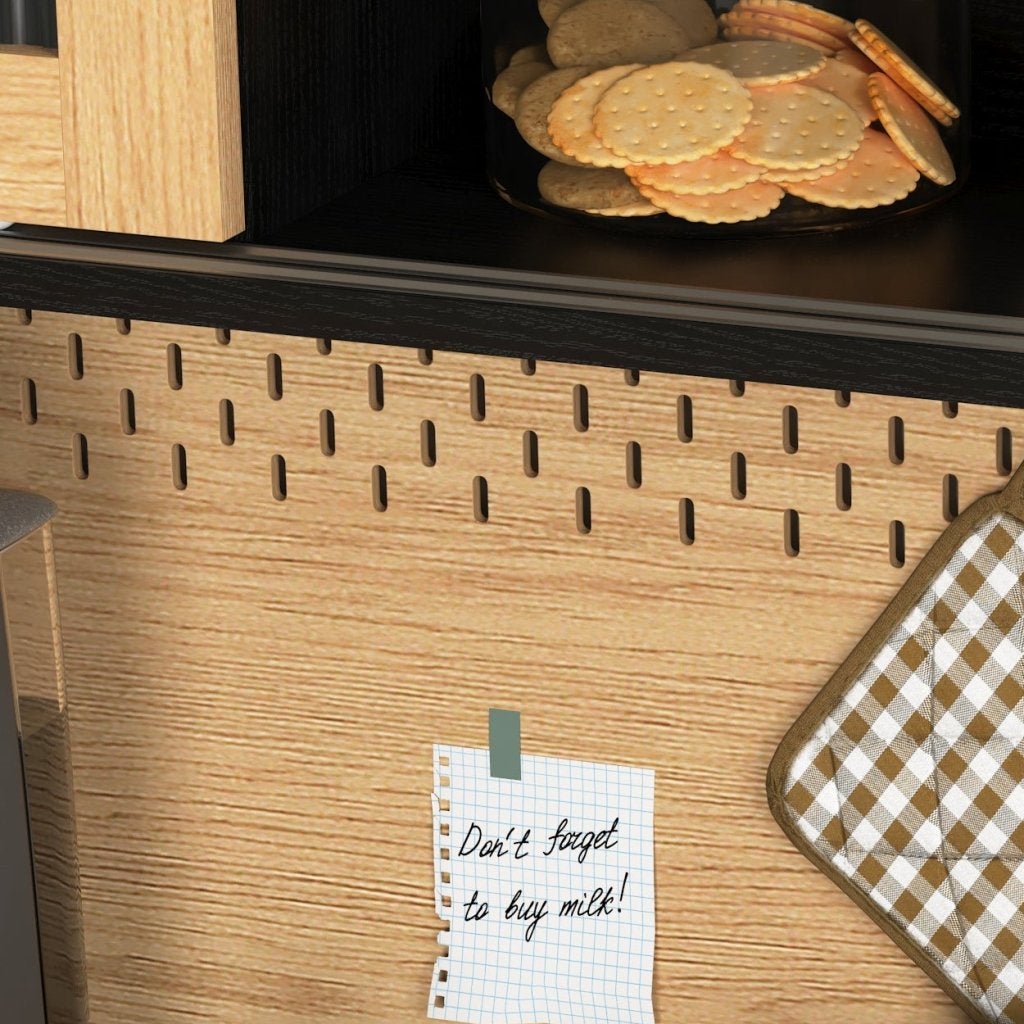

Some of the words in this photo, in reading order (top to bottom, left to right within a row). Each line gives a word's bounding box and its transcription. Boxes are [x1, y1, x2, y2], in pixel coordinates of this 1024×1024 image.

[458, 822, 531, 859] Don't
[543, 817, 619, 864] forget
[463, 890, 489, 922] to
[505, 890, 548, 942] buy
[559, 872, 629, 917] milk!
